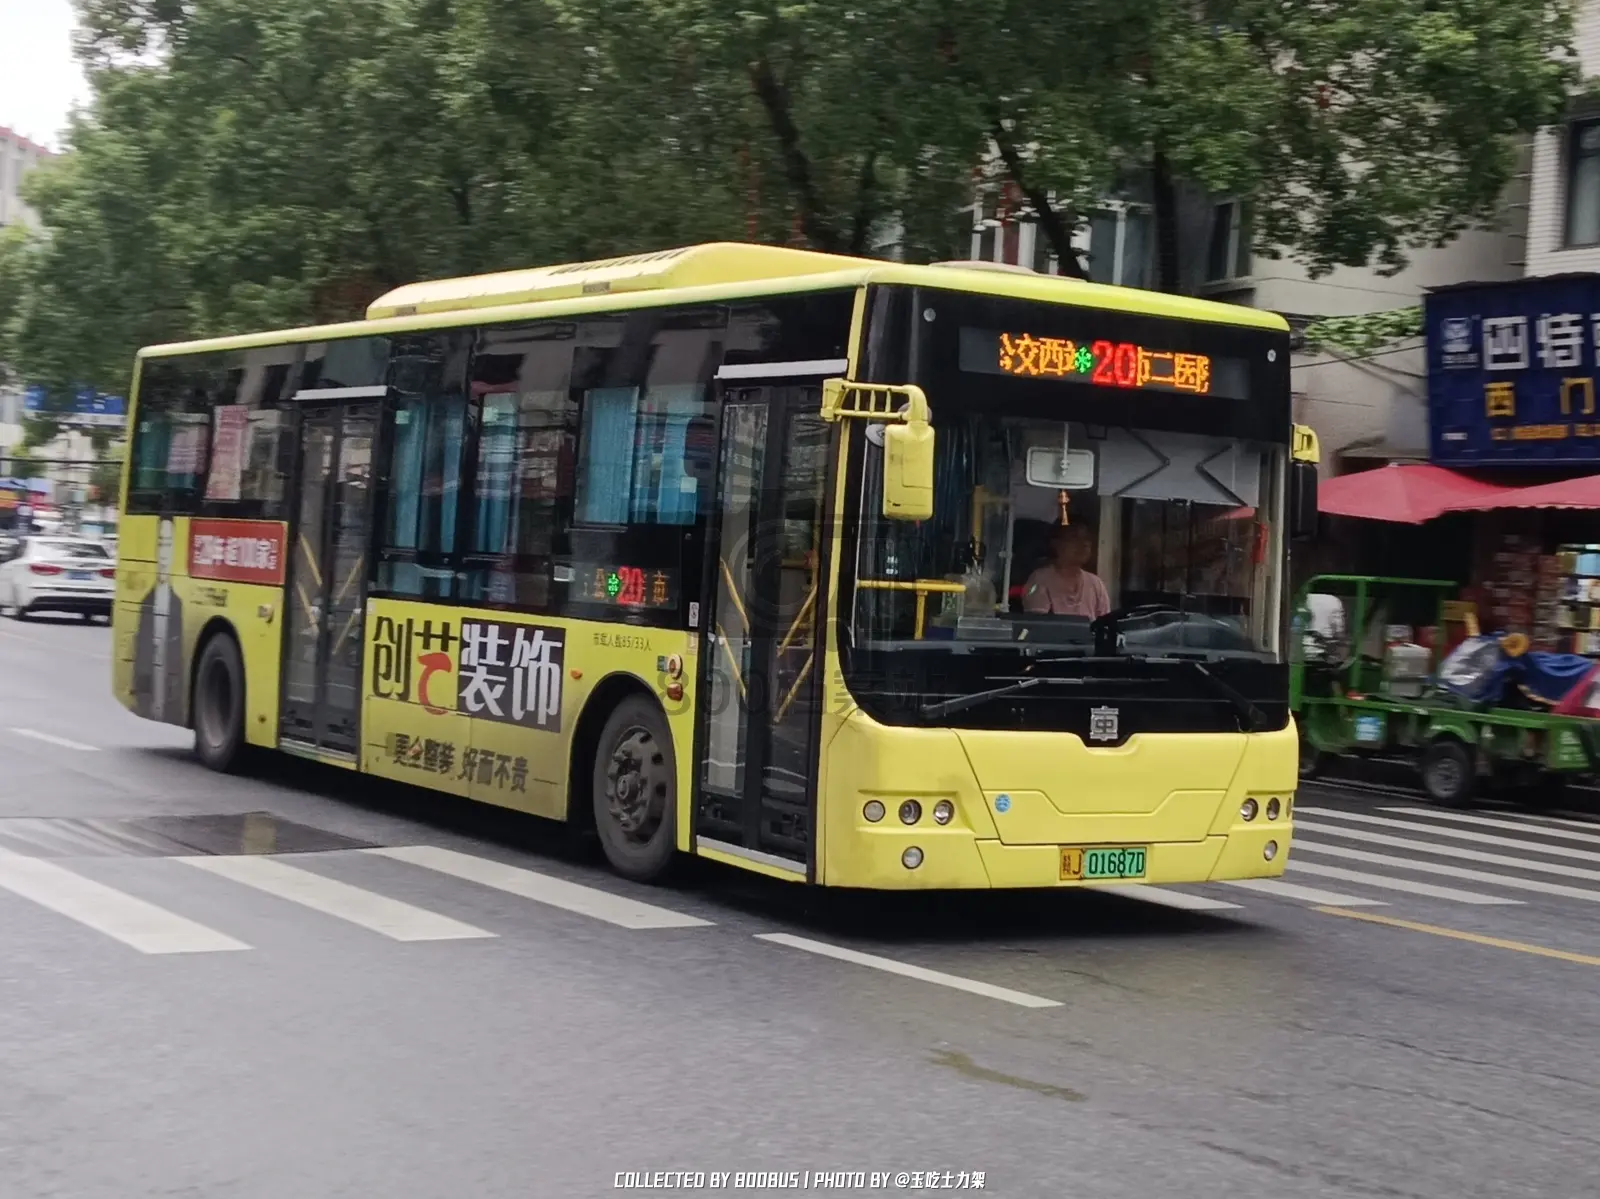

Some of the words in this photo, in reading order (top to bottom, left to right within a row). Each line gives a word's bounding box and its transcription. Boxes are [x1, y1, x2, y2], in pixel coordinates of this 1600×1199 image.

[1092, 340, 1137, 386] 20
[1482, 313, 1600, 370] 四特
[373, 615, 564, 725] 创艺装饰
